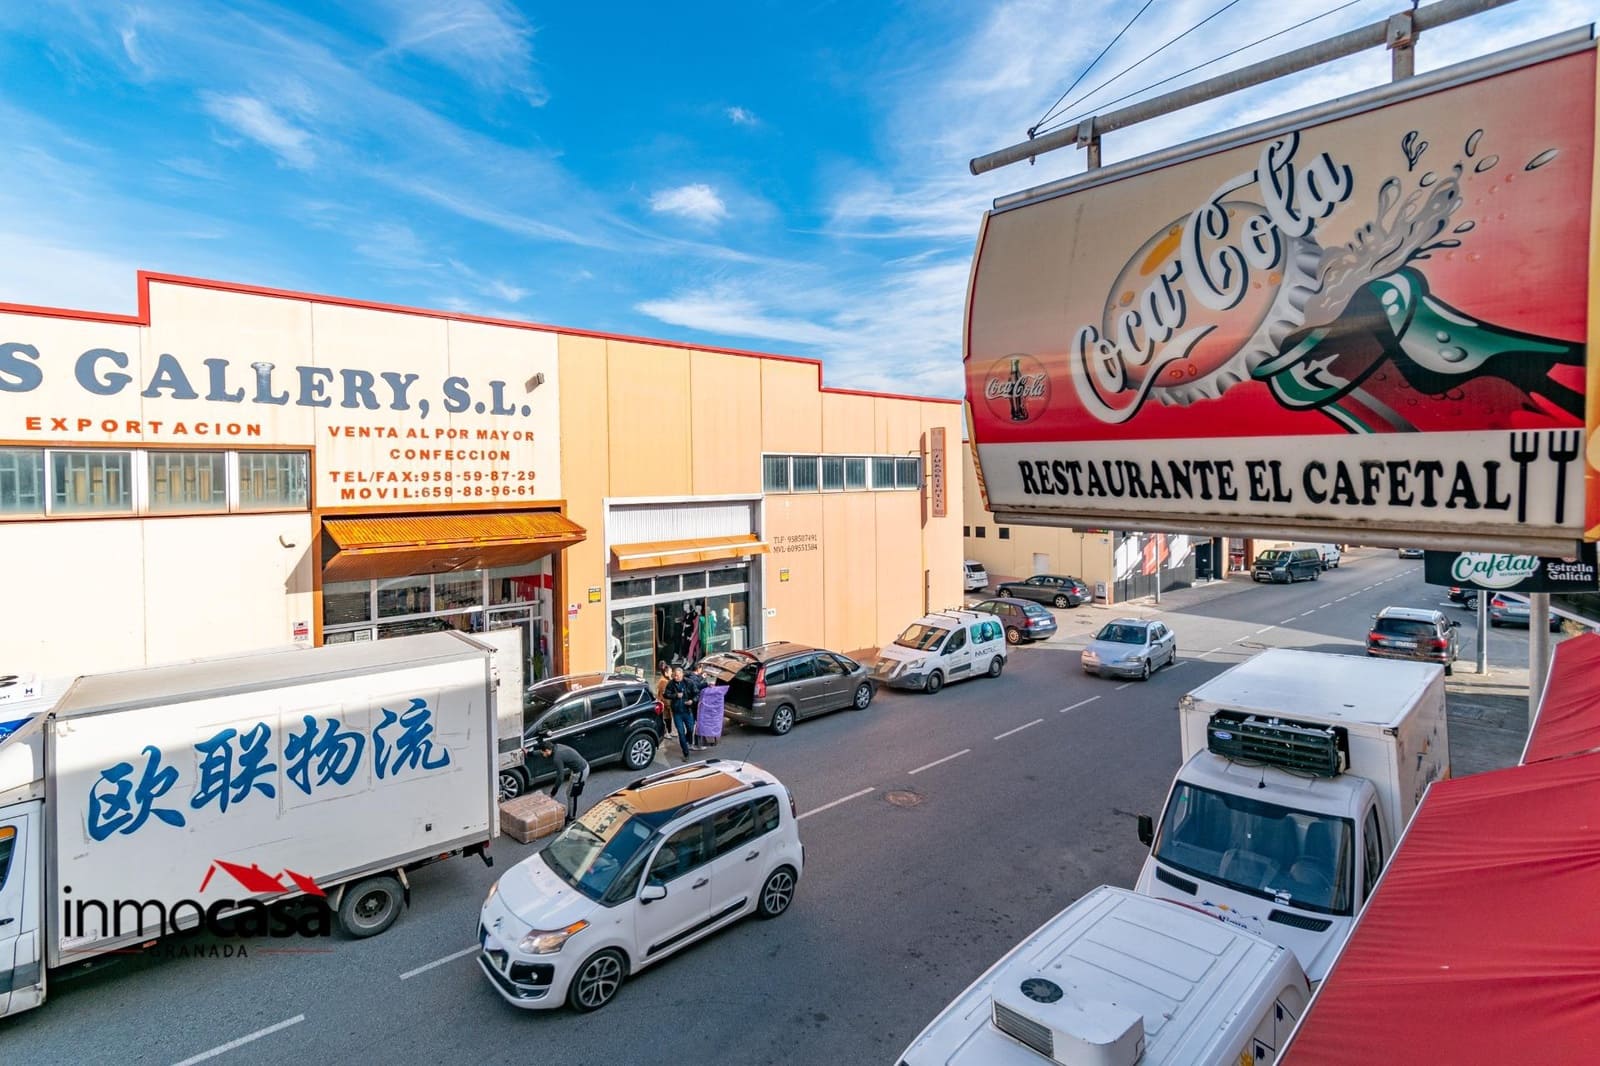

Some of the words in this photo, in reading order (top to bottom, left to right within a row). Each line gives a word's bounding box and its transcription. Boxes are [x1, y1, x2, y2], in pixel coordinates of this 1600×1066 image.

[75, 348, 430, 420] GALLERY,
[443, 376, 531, 417] S.L.
[25, 416, 262, 437] EXPORTACION
[328, 426, 398, 439] VENTA
[406, 428, 430, 439] AL
[435, 428, 470, 440] POR
[476, 429, 535, 442] MAYOR
[389, 448, 511, 461] CONFECCION
[1018, 460, 1238, 502] RESTAURANTE
[1245, 459, 1293, 503] EL
[1302, 459, 1512, 511] CAFETAL
[1546, 562, 1594, 573] Estrella
[1548, 571, 1593, 582] Galicia
[87, 697, 452, 843] 欧联物流
